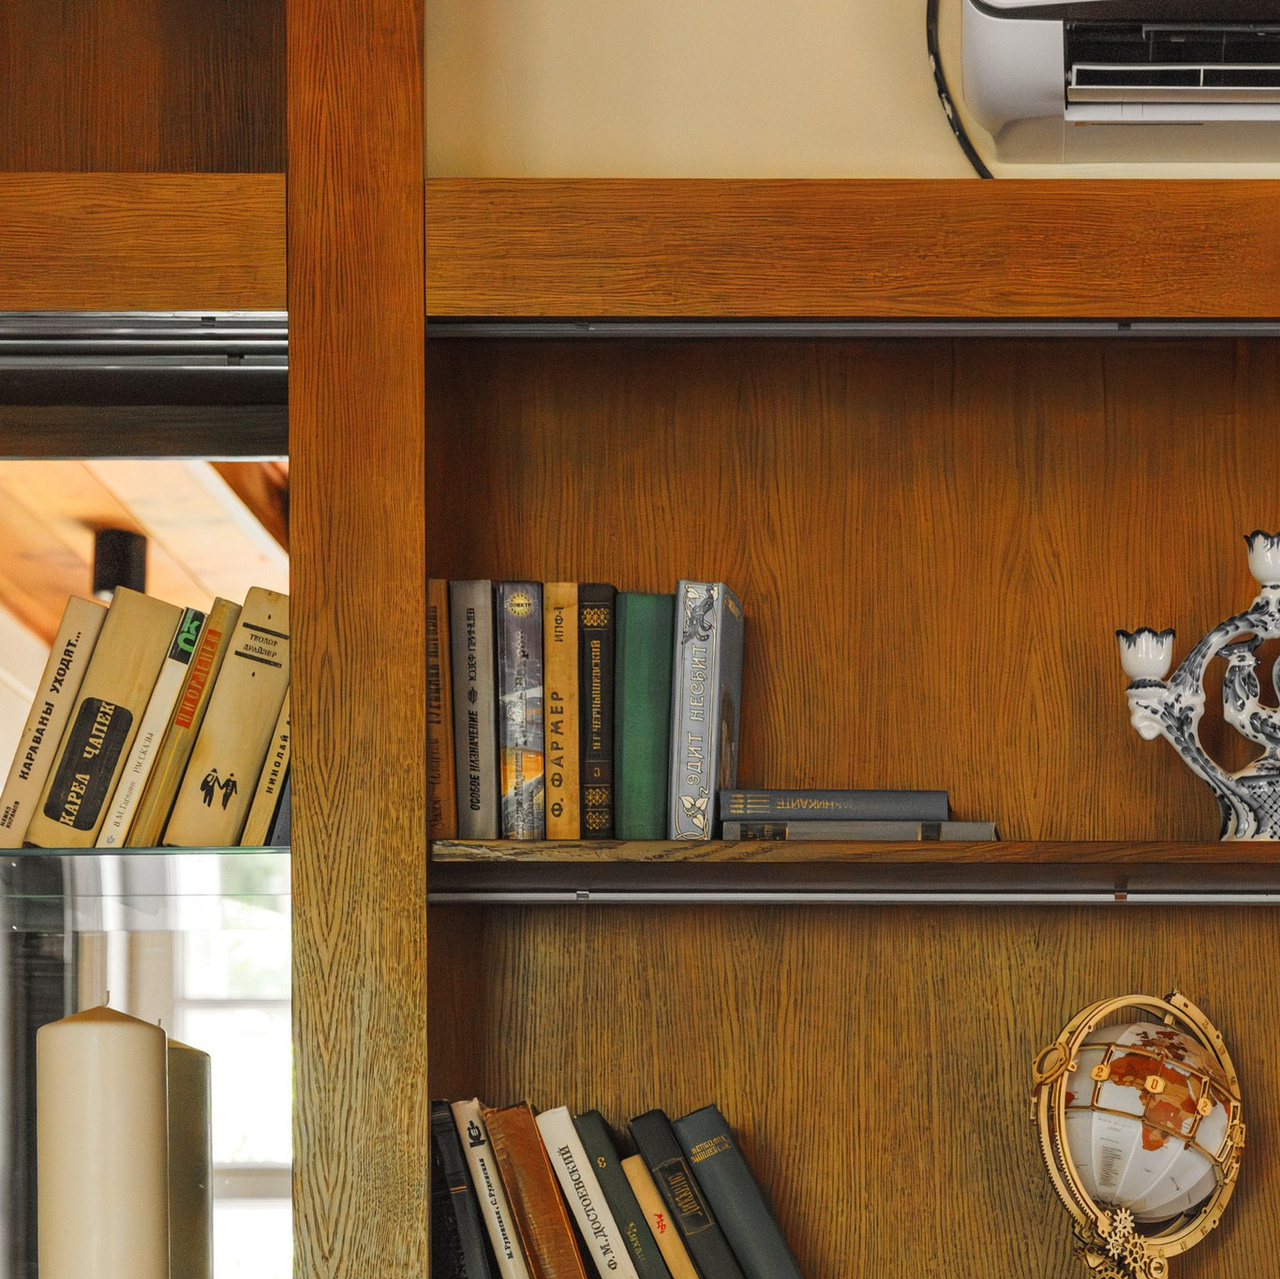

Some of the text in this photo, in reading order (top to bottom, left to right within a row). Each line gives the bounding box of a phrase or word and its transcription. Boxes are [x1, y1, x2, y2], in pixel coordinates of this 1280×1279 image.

[19, 631, 82, 780] КАРАВАНЫ УХОДЯТ...
[467, 608, 477, 682] ЮЗЕФ ПРИНЦЕВ
[59, 701, 116, 827] КАРЕЛ ЧАПЕК
[265, 733, 289, 794] НИКОЛАЙ
[469, 709, 480, 811] ОСОБОЕ НАЗНАЧЕНИЕ
[550, 690, 565, 819] Ф. ФАРМЕР
[686, 643, 709, 787] ЭДИТ НЕСБИТ
